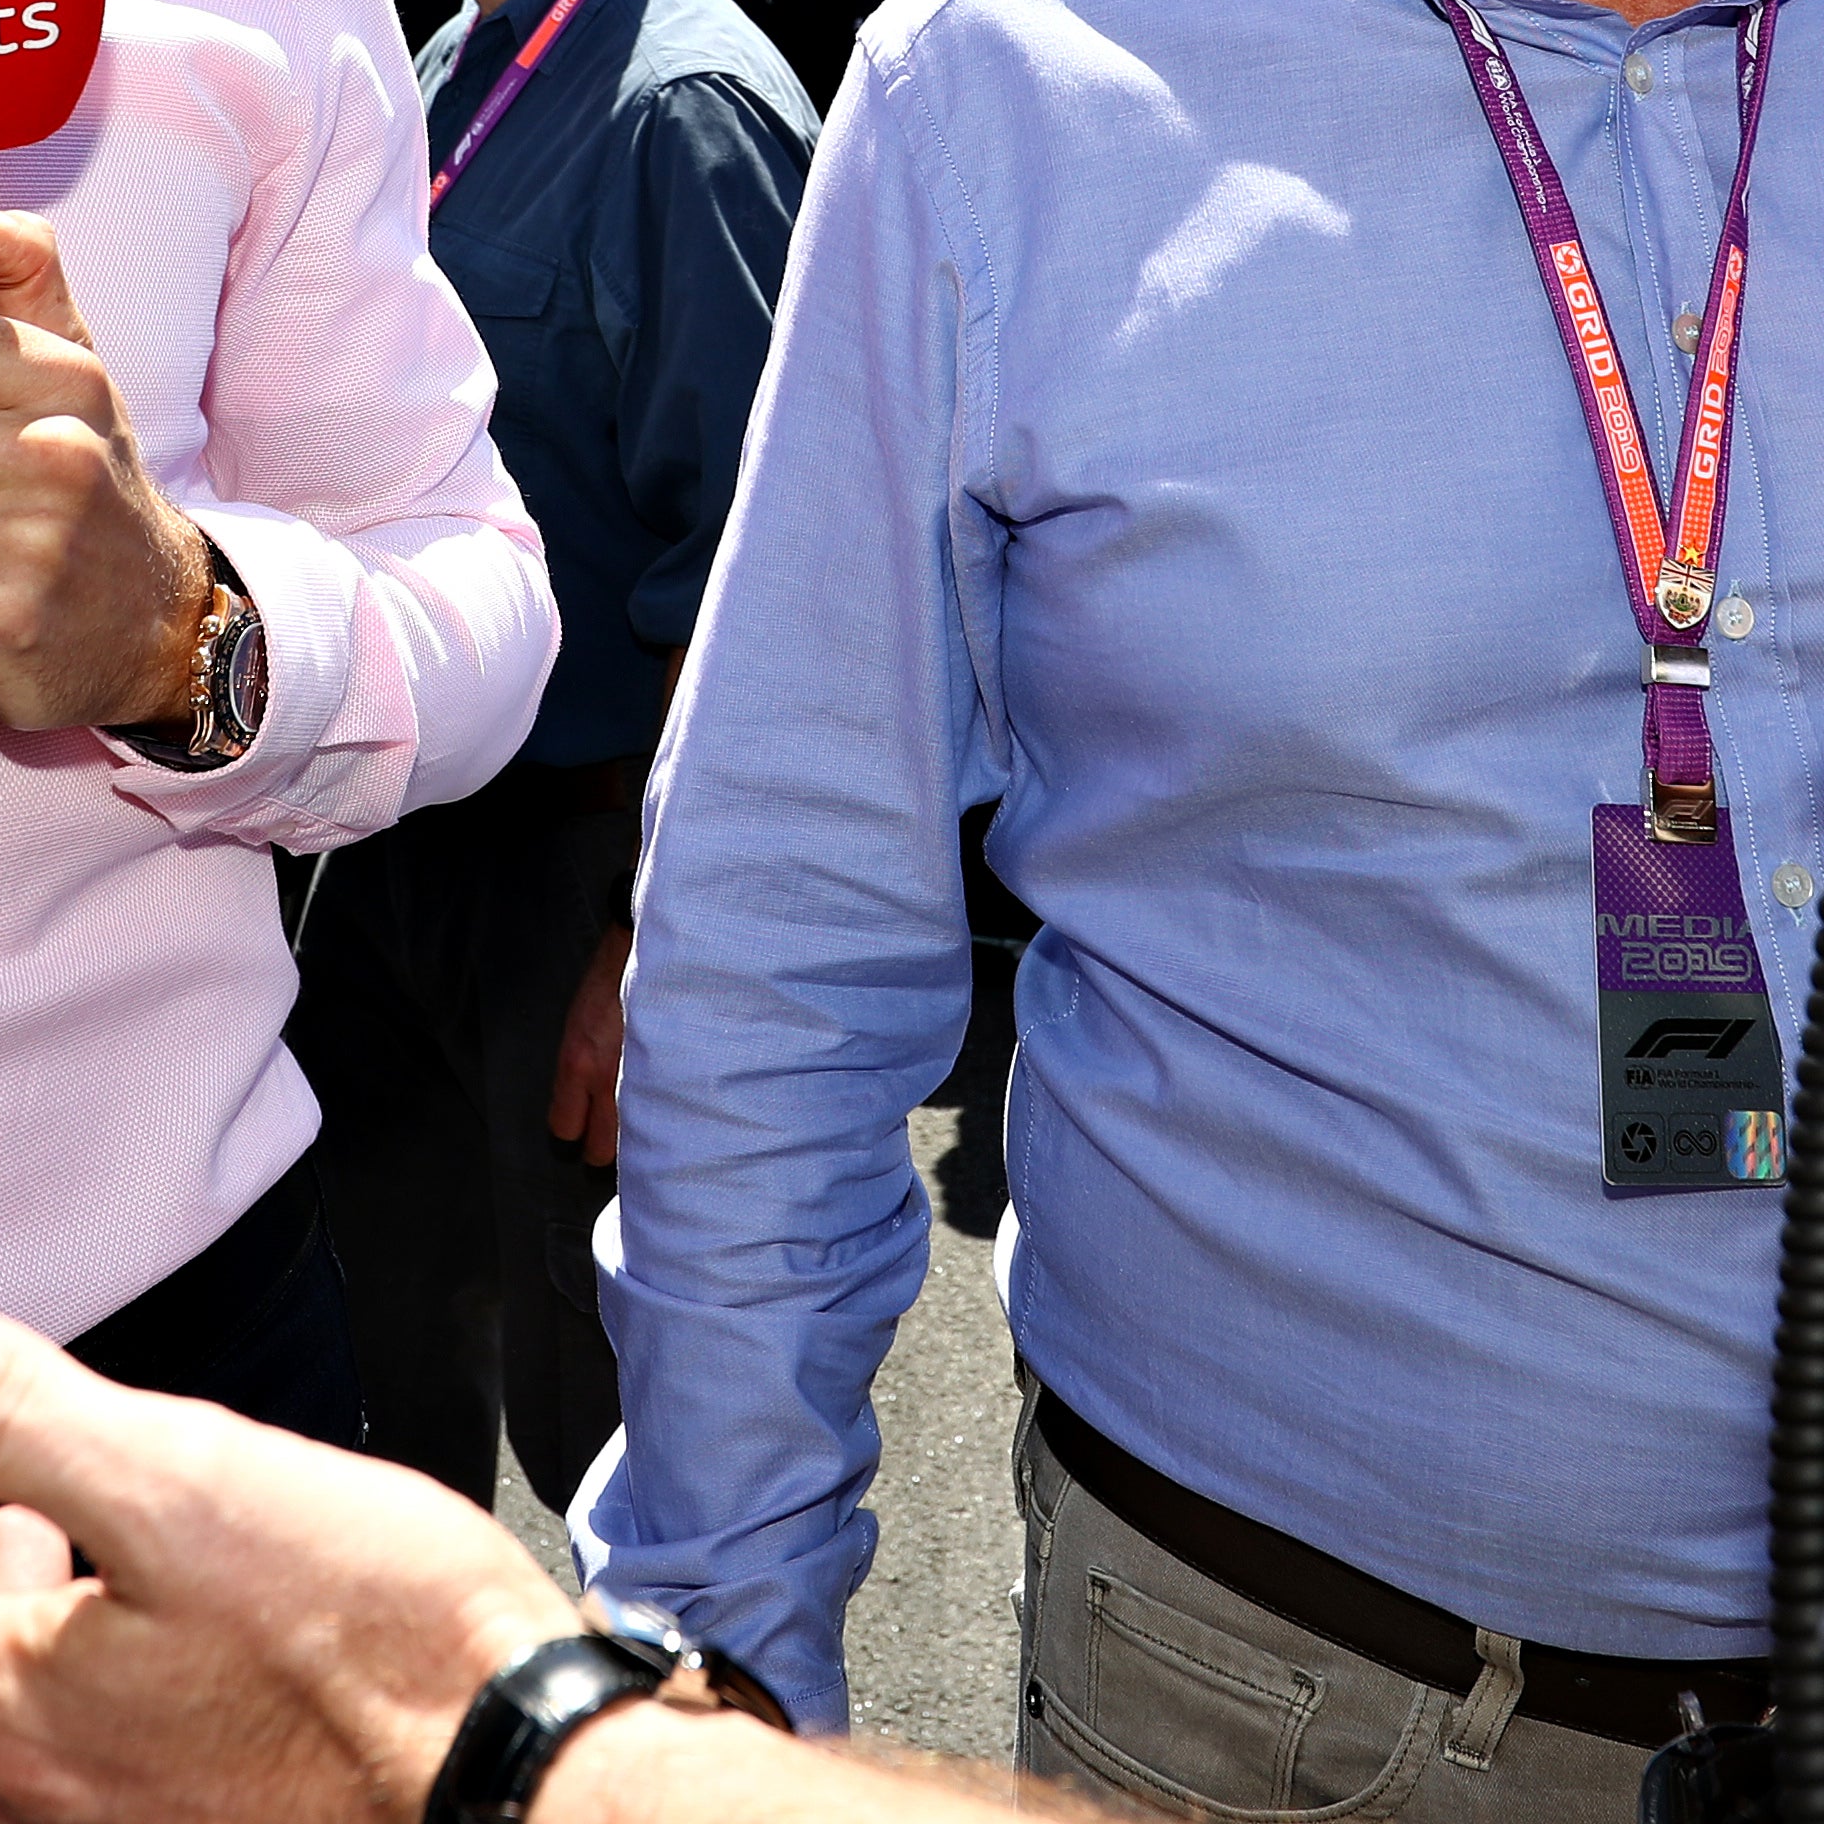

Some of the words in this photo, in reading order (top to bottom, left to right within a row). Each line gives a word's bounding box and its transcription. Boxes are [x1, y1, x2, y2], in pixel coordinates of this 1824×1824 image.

[1566, 281, 1613, 378] GRID
[1598, 384, 1641, 474] 2019
[1695, 384, 1725, 481] GRID
[1715, 288, 1737, 377] 2019
[1621, 941, 1755, 983] 2019
[1626, 1068, 1654, 1086] FIA
